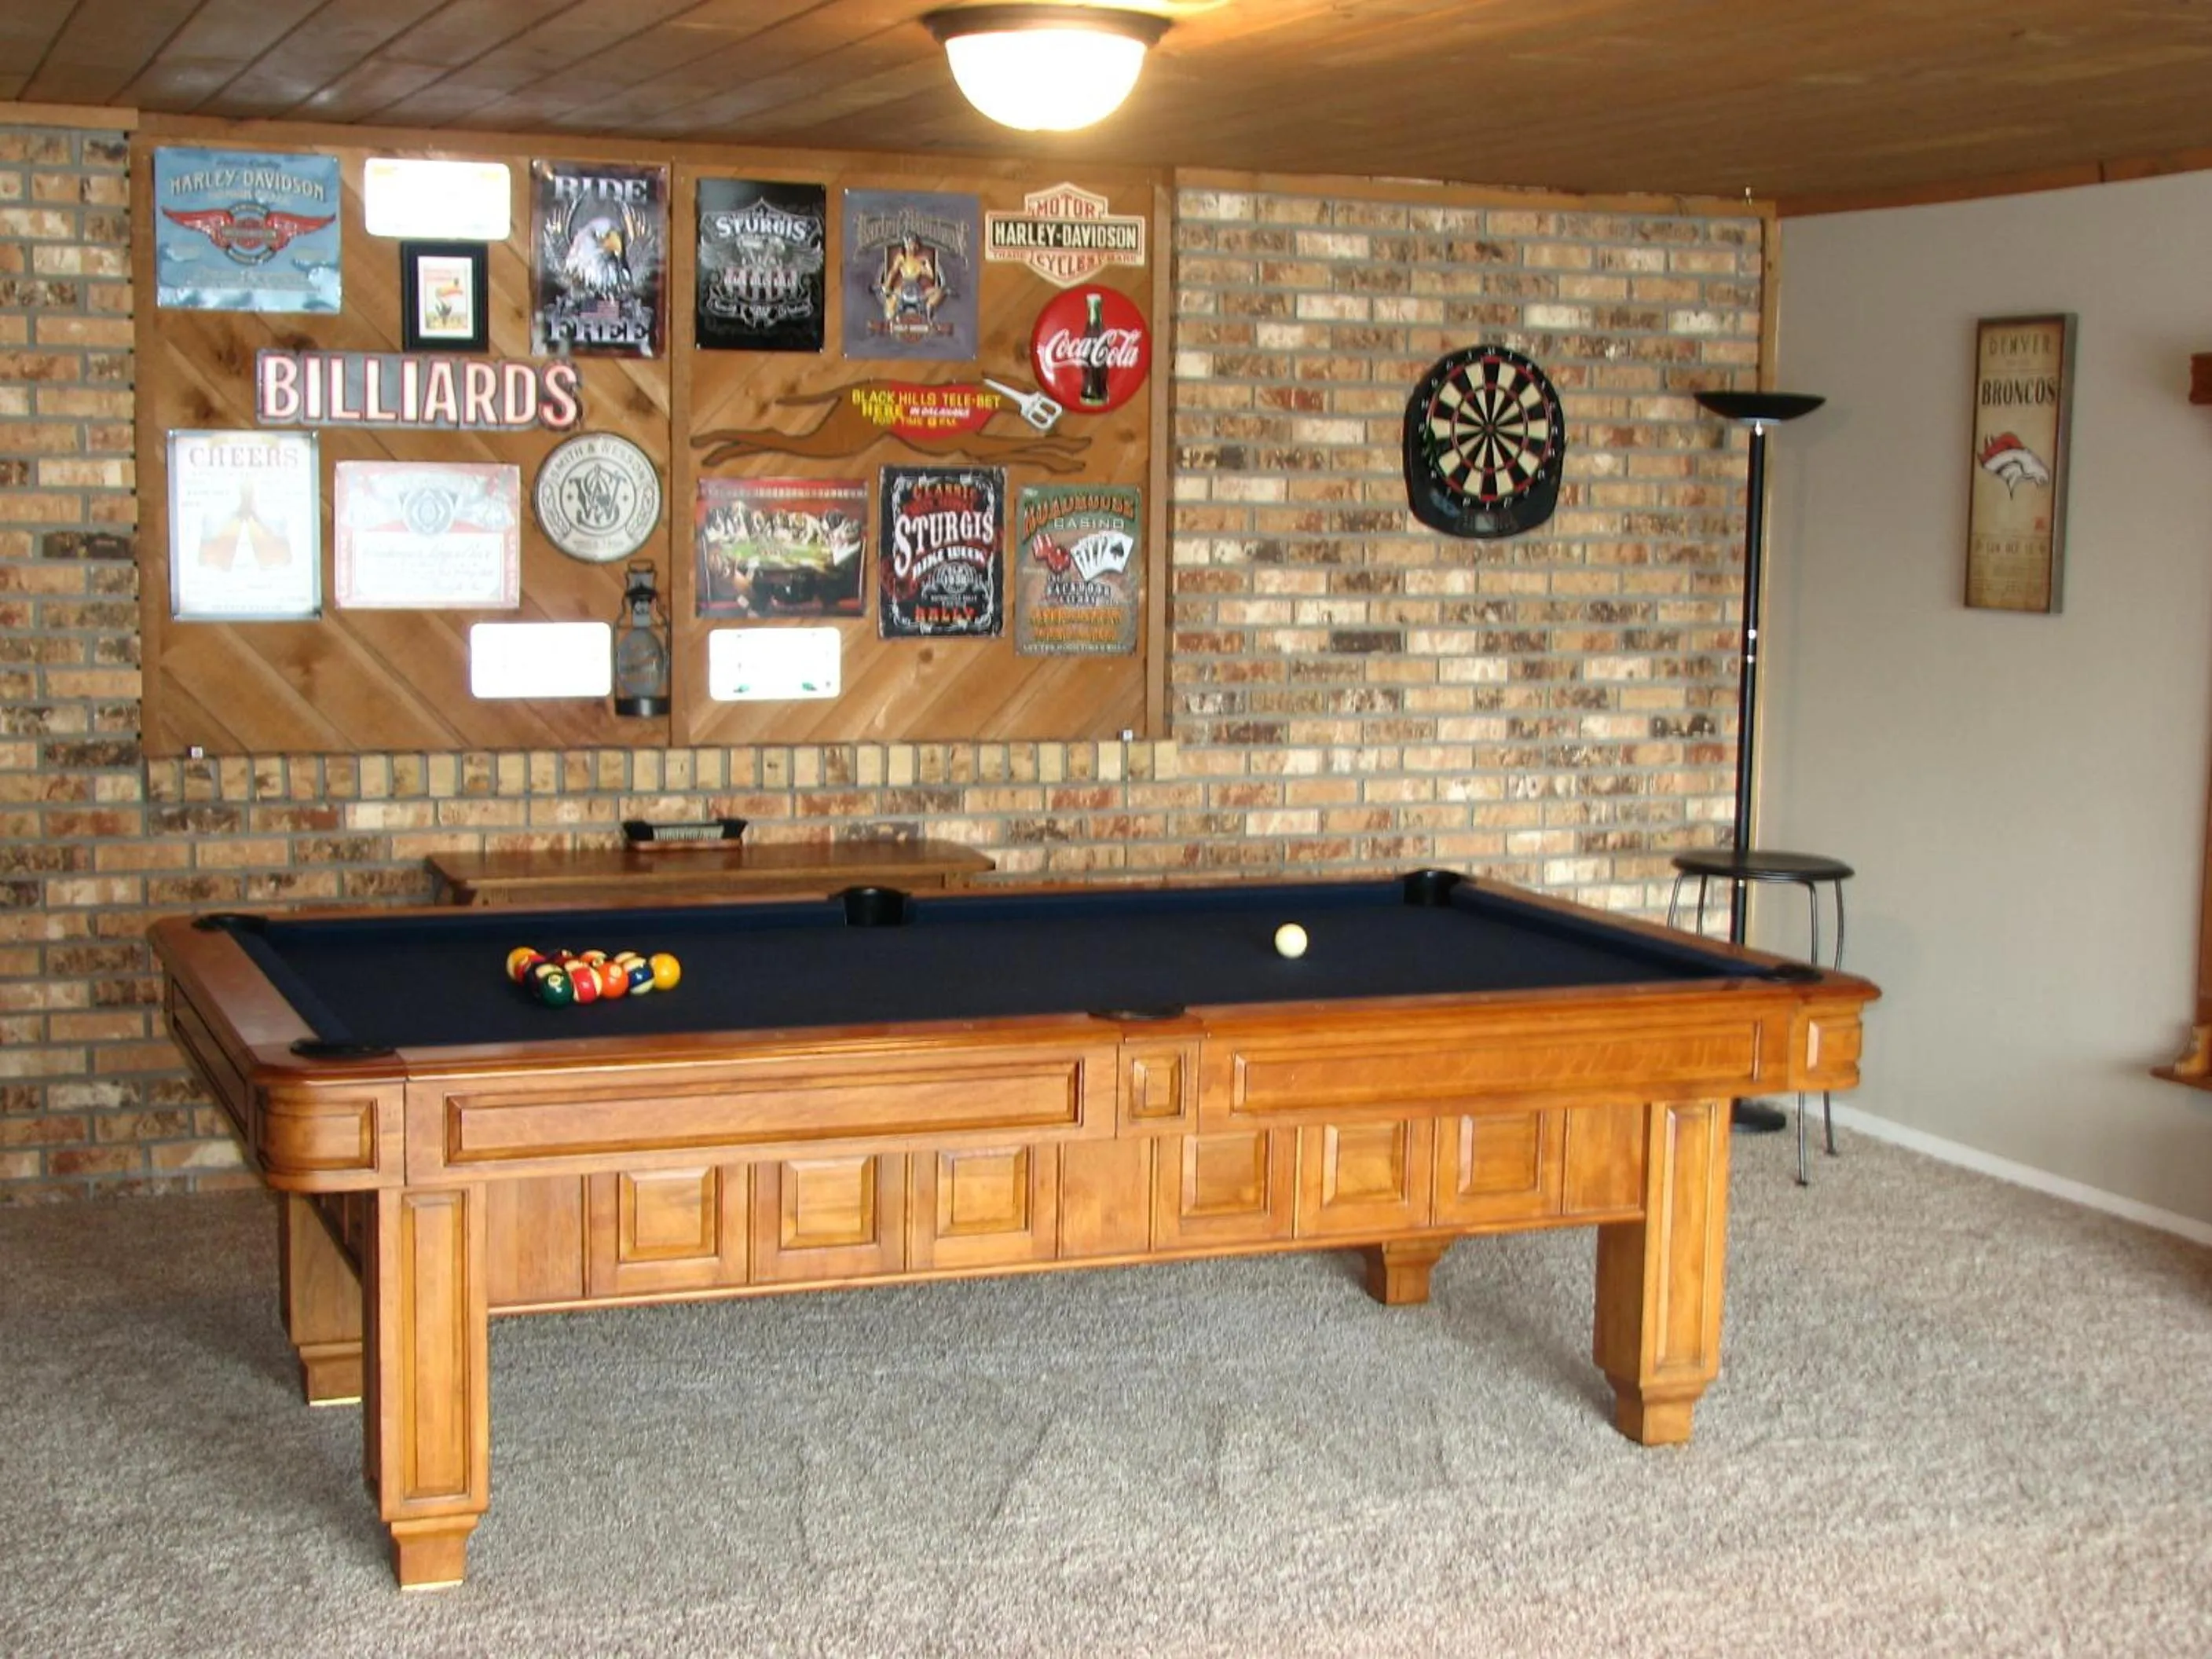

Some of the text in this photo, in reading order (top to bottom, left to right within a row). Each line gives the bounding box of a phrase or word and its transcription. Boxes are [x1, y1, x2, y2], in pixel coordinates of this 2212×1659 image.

[555, 176, 647, 203] RIDE
[1037, 194, 1096, 217] MOTOR
[716, 214, 808, 240] STURGIS
[994, 222, 1137, 249] HARLEY-DAVIDSON
[548, 316, 650, 343] FREE
[1989, 333, 2051, 356] DENVER
[263, 354, 579, 428] BILLIARDS
[851, 389, 1002, 409] BLACK HILLS TELE-BET
[1981, 376, 2056, 407] BRONCOS
[189, 445, 299, 469] CHEERS
[1053, 518, 1125, 530] CASINO
[894, 511, 994, 579] STURGIS
[914, 606, 976, 624] RALLY
